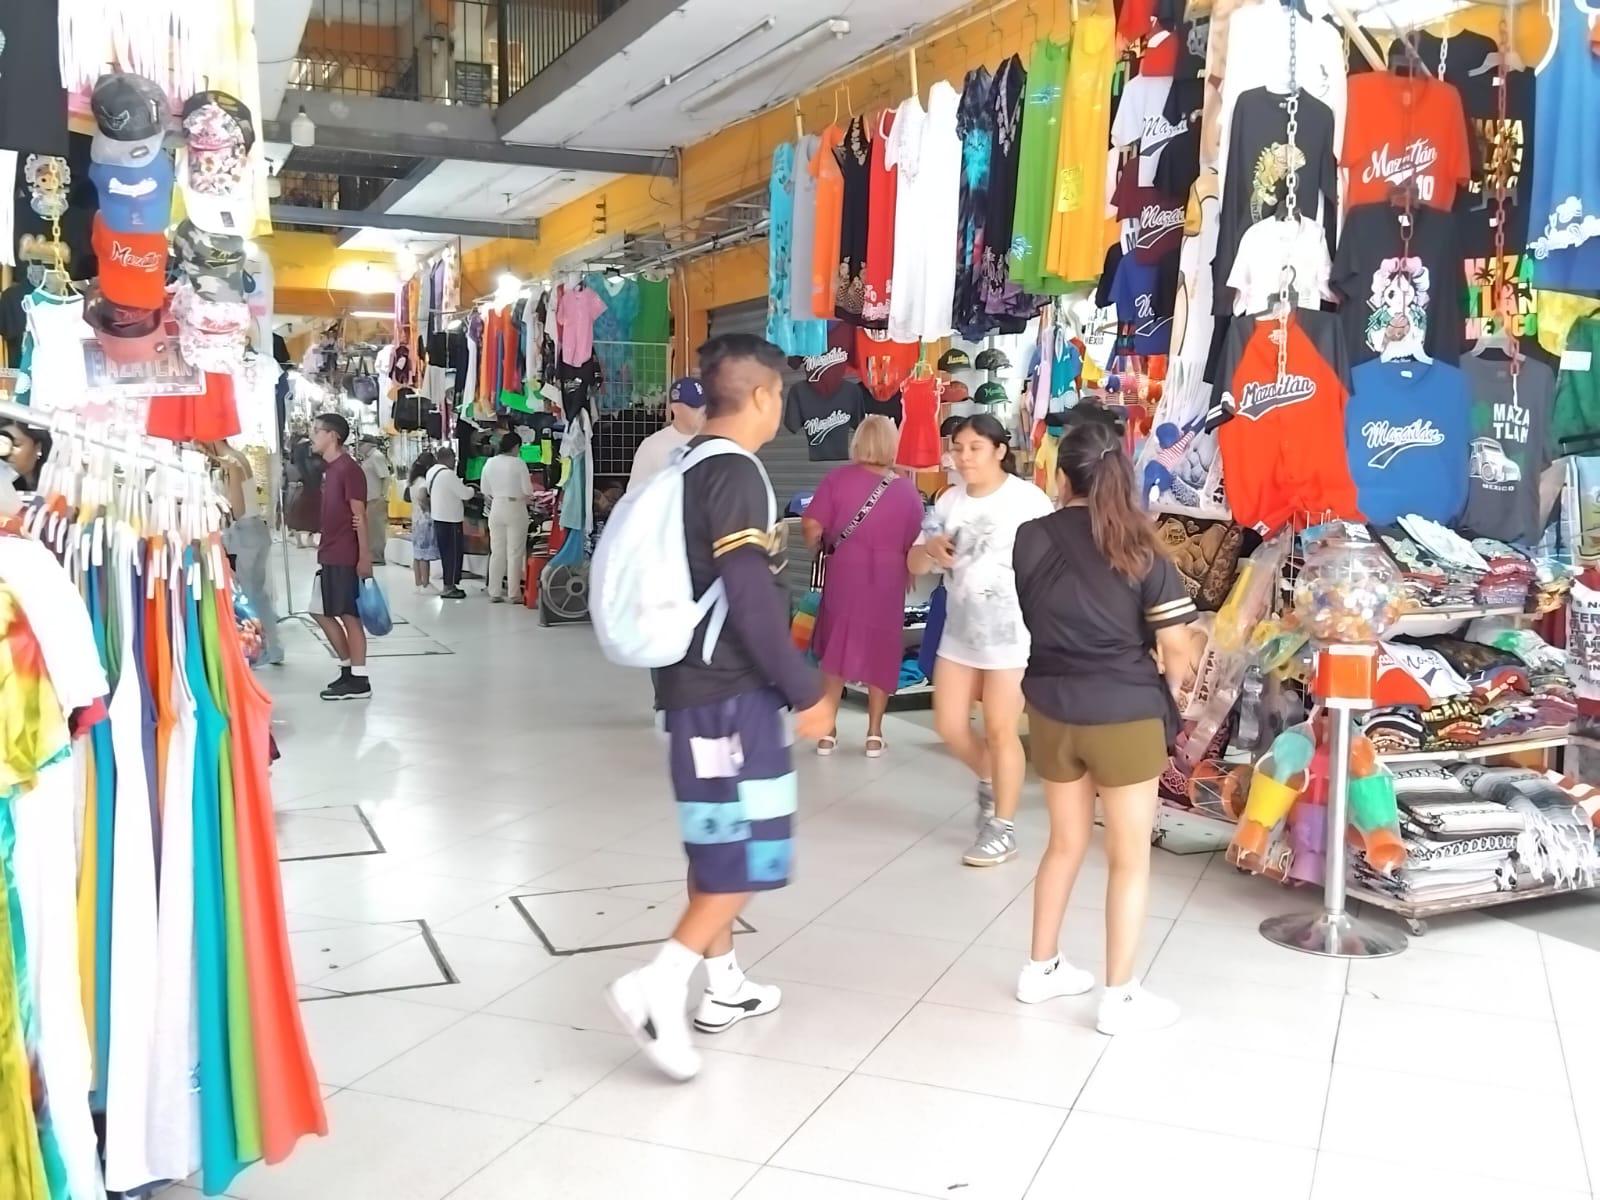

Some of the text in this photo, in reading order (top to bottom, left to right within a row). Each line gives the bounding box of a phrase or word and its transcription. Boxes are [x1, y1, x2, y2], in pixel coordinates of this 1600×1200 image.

[1416, 174, 1435, 201] 10
[1493, 403, 1530, 426] MAZA
[1493, 422, 1529, 443] TLAN
